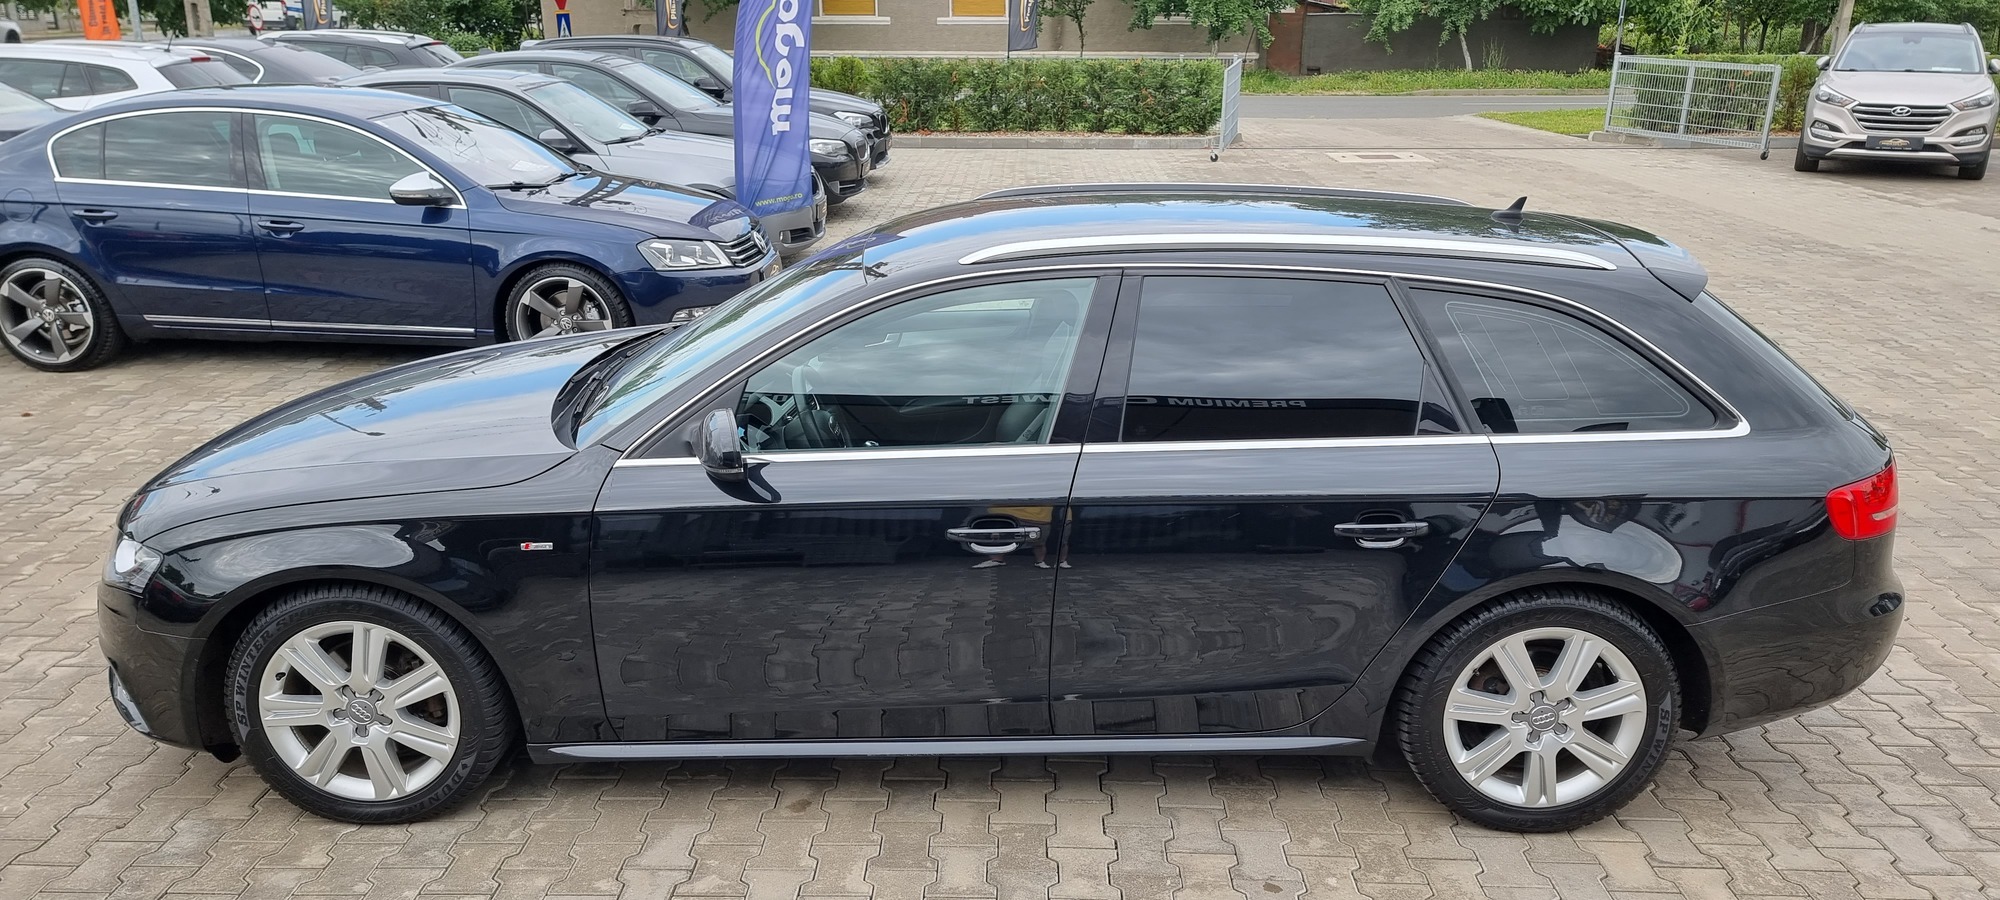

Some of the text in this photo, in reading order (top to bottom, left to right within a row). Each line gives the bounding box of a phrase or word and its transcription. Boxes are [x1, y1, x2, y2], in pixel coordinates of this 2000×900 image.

[236, 630, 273, 727] SP WINTER
[1659, 708, 1670, 733] SP
